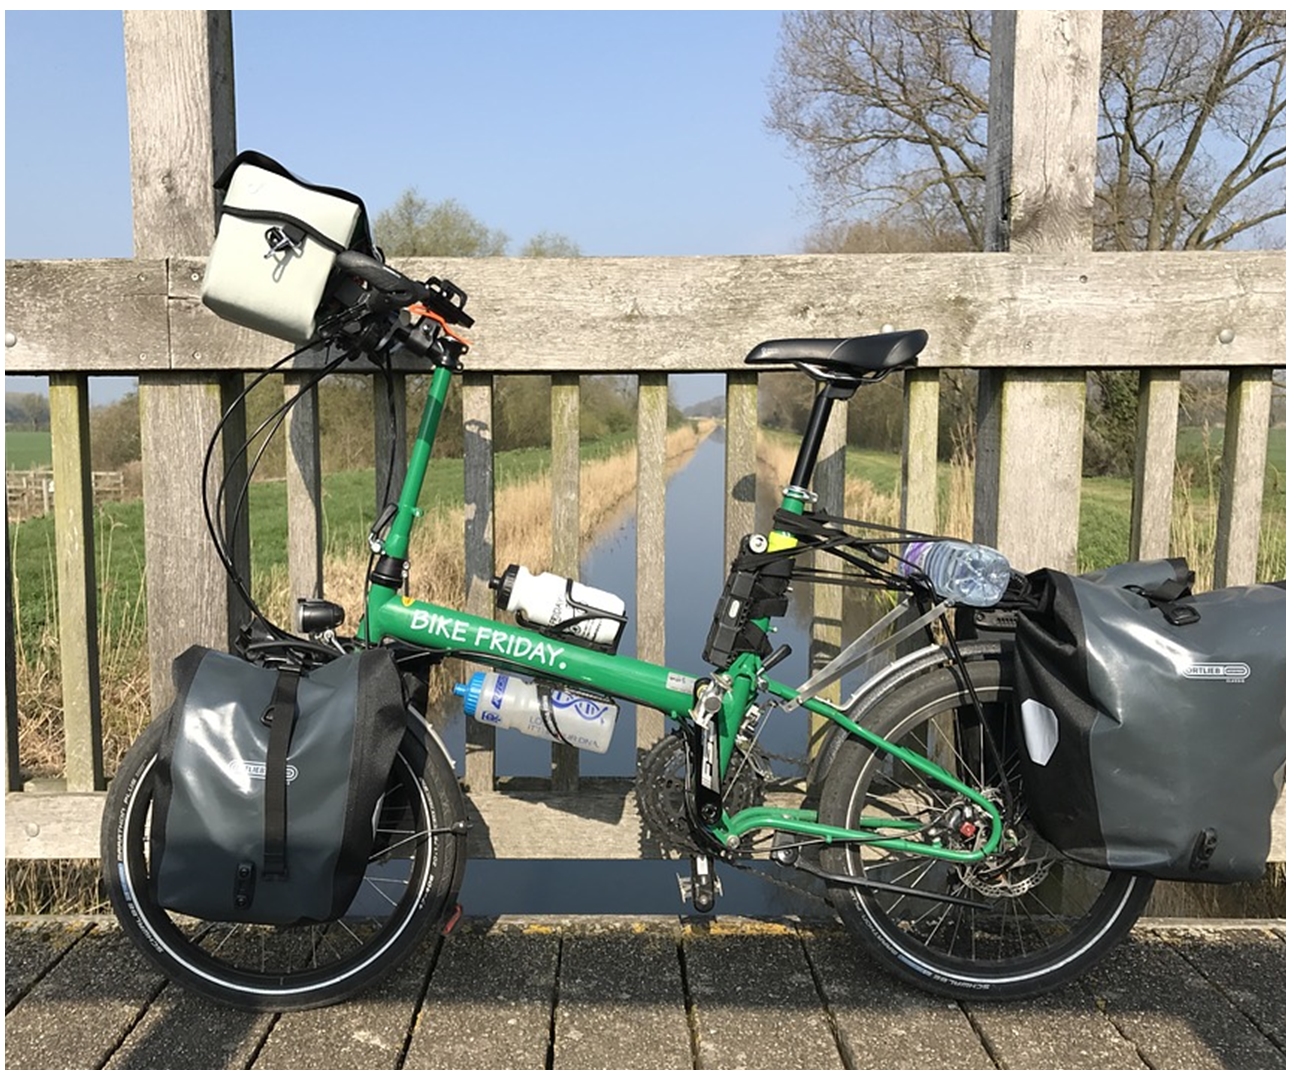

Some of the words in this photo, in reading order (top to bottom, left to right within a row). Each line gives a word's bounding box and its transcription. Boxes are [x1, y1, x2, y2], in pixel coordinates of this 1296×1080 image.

[410, 609, 469, 643] BIKE
[474, 626, 567, 669] FRIDAY.
[127, 902, 164, 954] SCHWALBE
